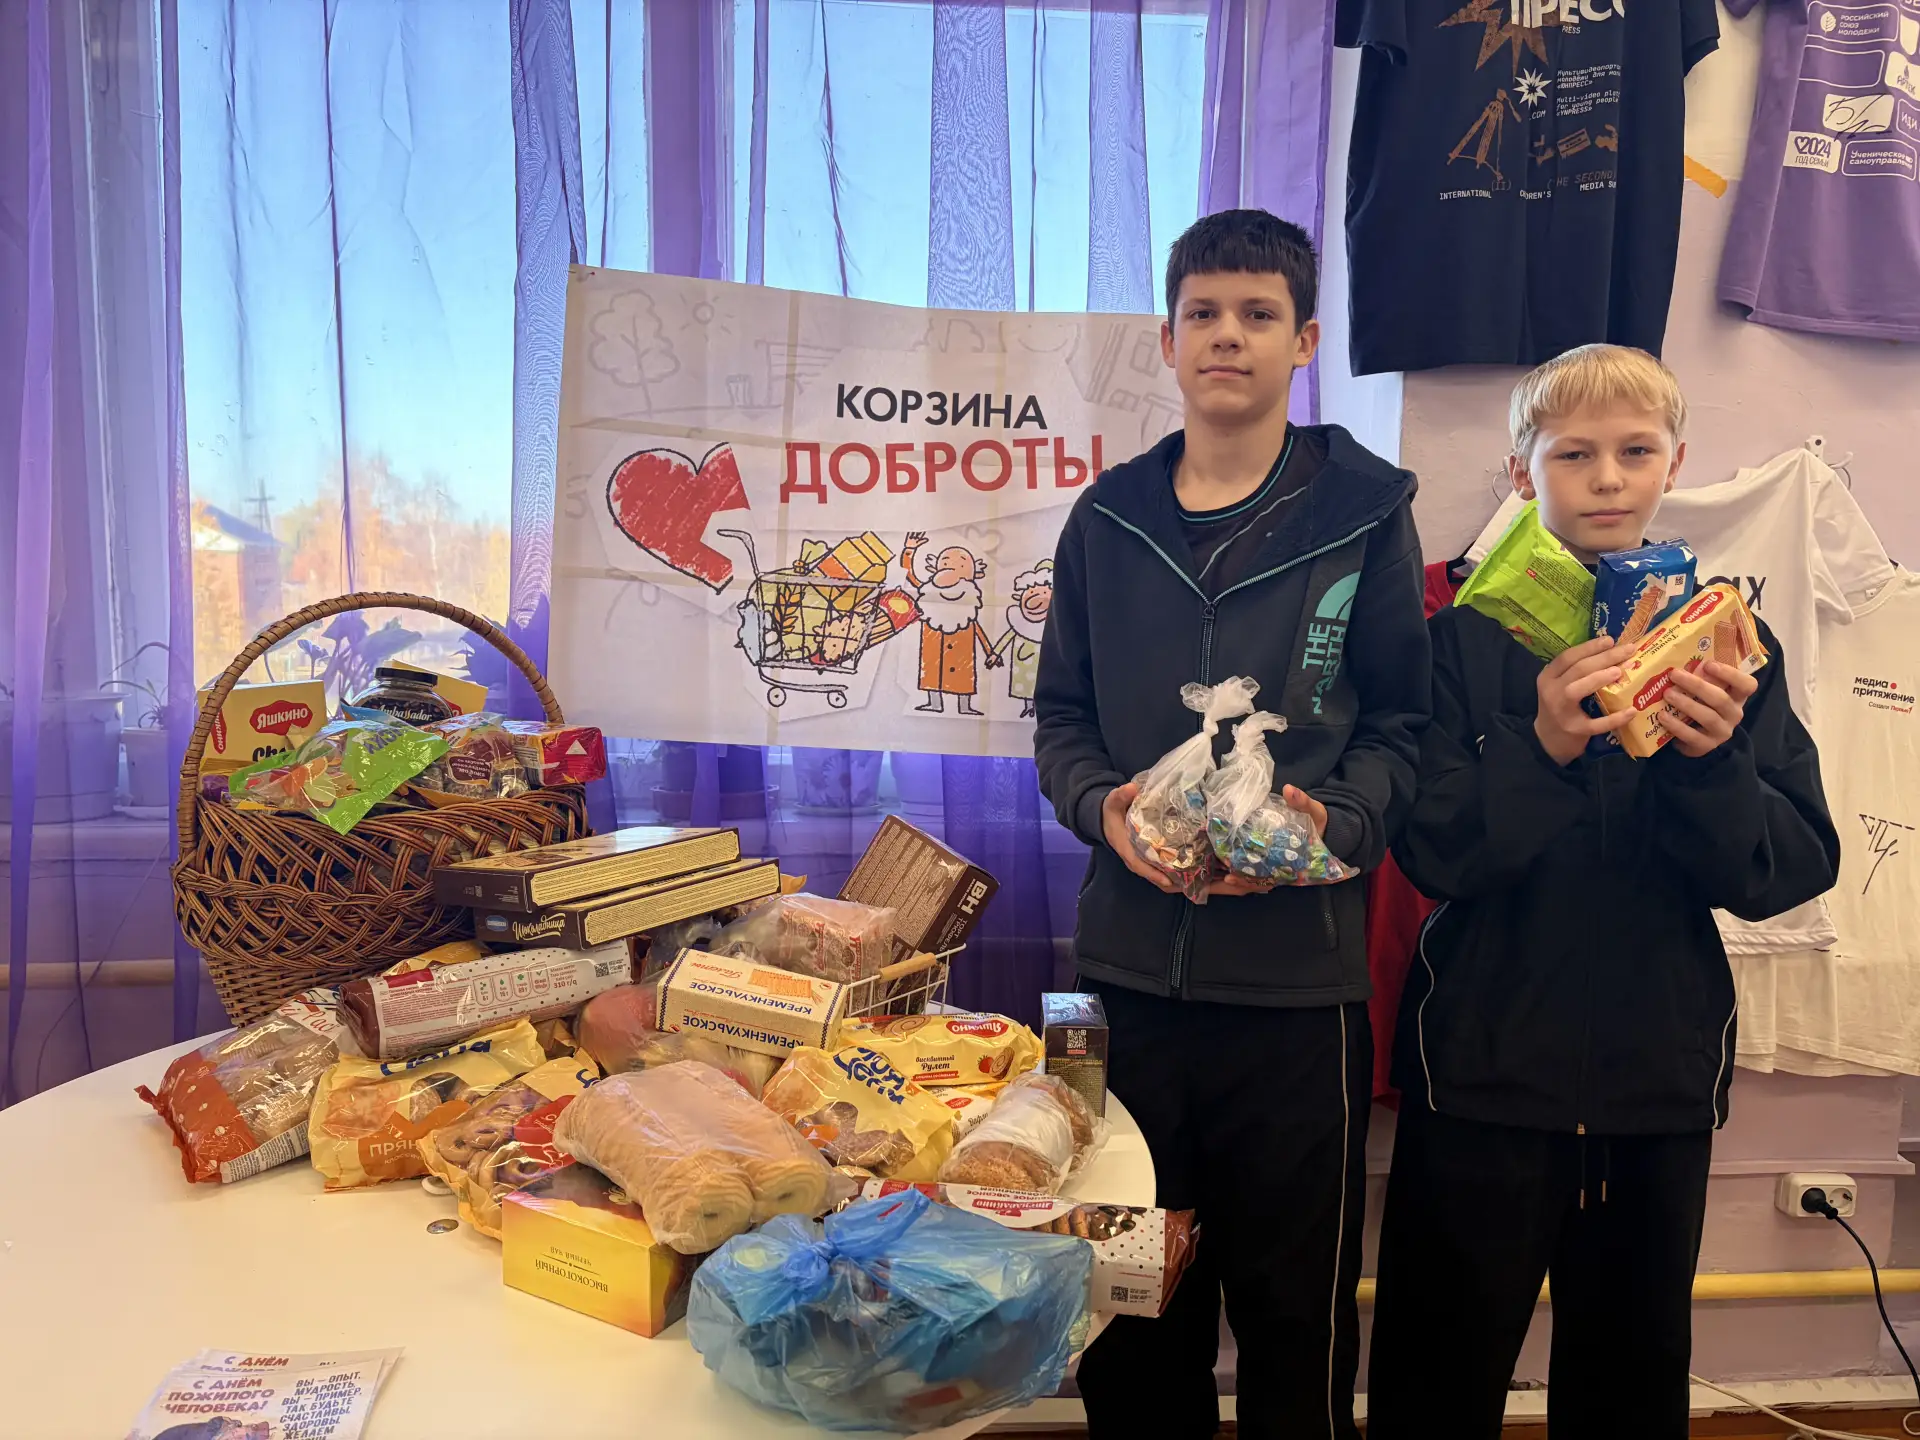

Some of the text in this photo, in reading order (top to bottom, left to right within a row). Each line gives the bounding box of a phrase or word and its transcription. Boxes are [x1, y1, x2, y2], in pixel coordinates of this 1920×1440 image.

[1561, 26, 1580, 34] PRESS
[1896, 76, 1916, 95] АРТЕК
[1795, 155, 1808, 166] ГОД
[1439, 189, 1492, 200] INTERNATIONAL
[1579, 181, 1605, 192] MEDIA
[836, 383, 1047, 430] КОРЗИНА
[779, 434, 1103, 505] ДОБРОТЫ
[1302, 622, 1331, 670] THE
[1637, 673, 1671, 709] Яшкин
[1854, 676, 1889, 689] медиа
[1852, 687, 1915, 704] притяжение
[688, 981, 813, 1015] КРЕМЕНКУЛЬСКОЕ
[682, 1014, 804, 1050] КРЕМЕНКУЛЬСКОЕ
[535, 1258, 609, 1293] ВЫСОКОГОРНЫЙ
[223, 1355, 290, 1367] С ДНЁМ
[192, 1377, 263, 1390] С ДНЁМ
[296, 1378, 315, 1388] ВЫ
[167, 1388, 275, 1401] ПОЖИЛОГО
[281, 1396, 301, 1406] ВЫ
[164, 1400, 269, 1414] ЧЕЛОВЕКА!
[285, 1396, 354, 1414] ТАК БУДЬТЕ
[284, 1425, 335, 1440] ЖЕЛАЕМ
